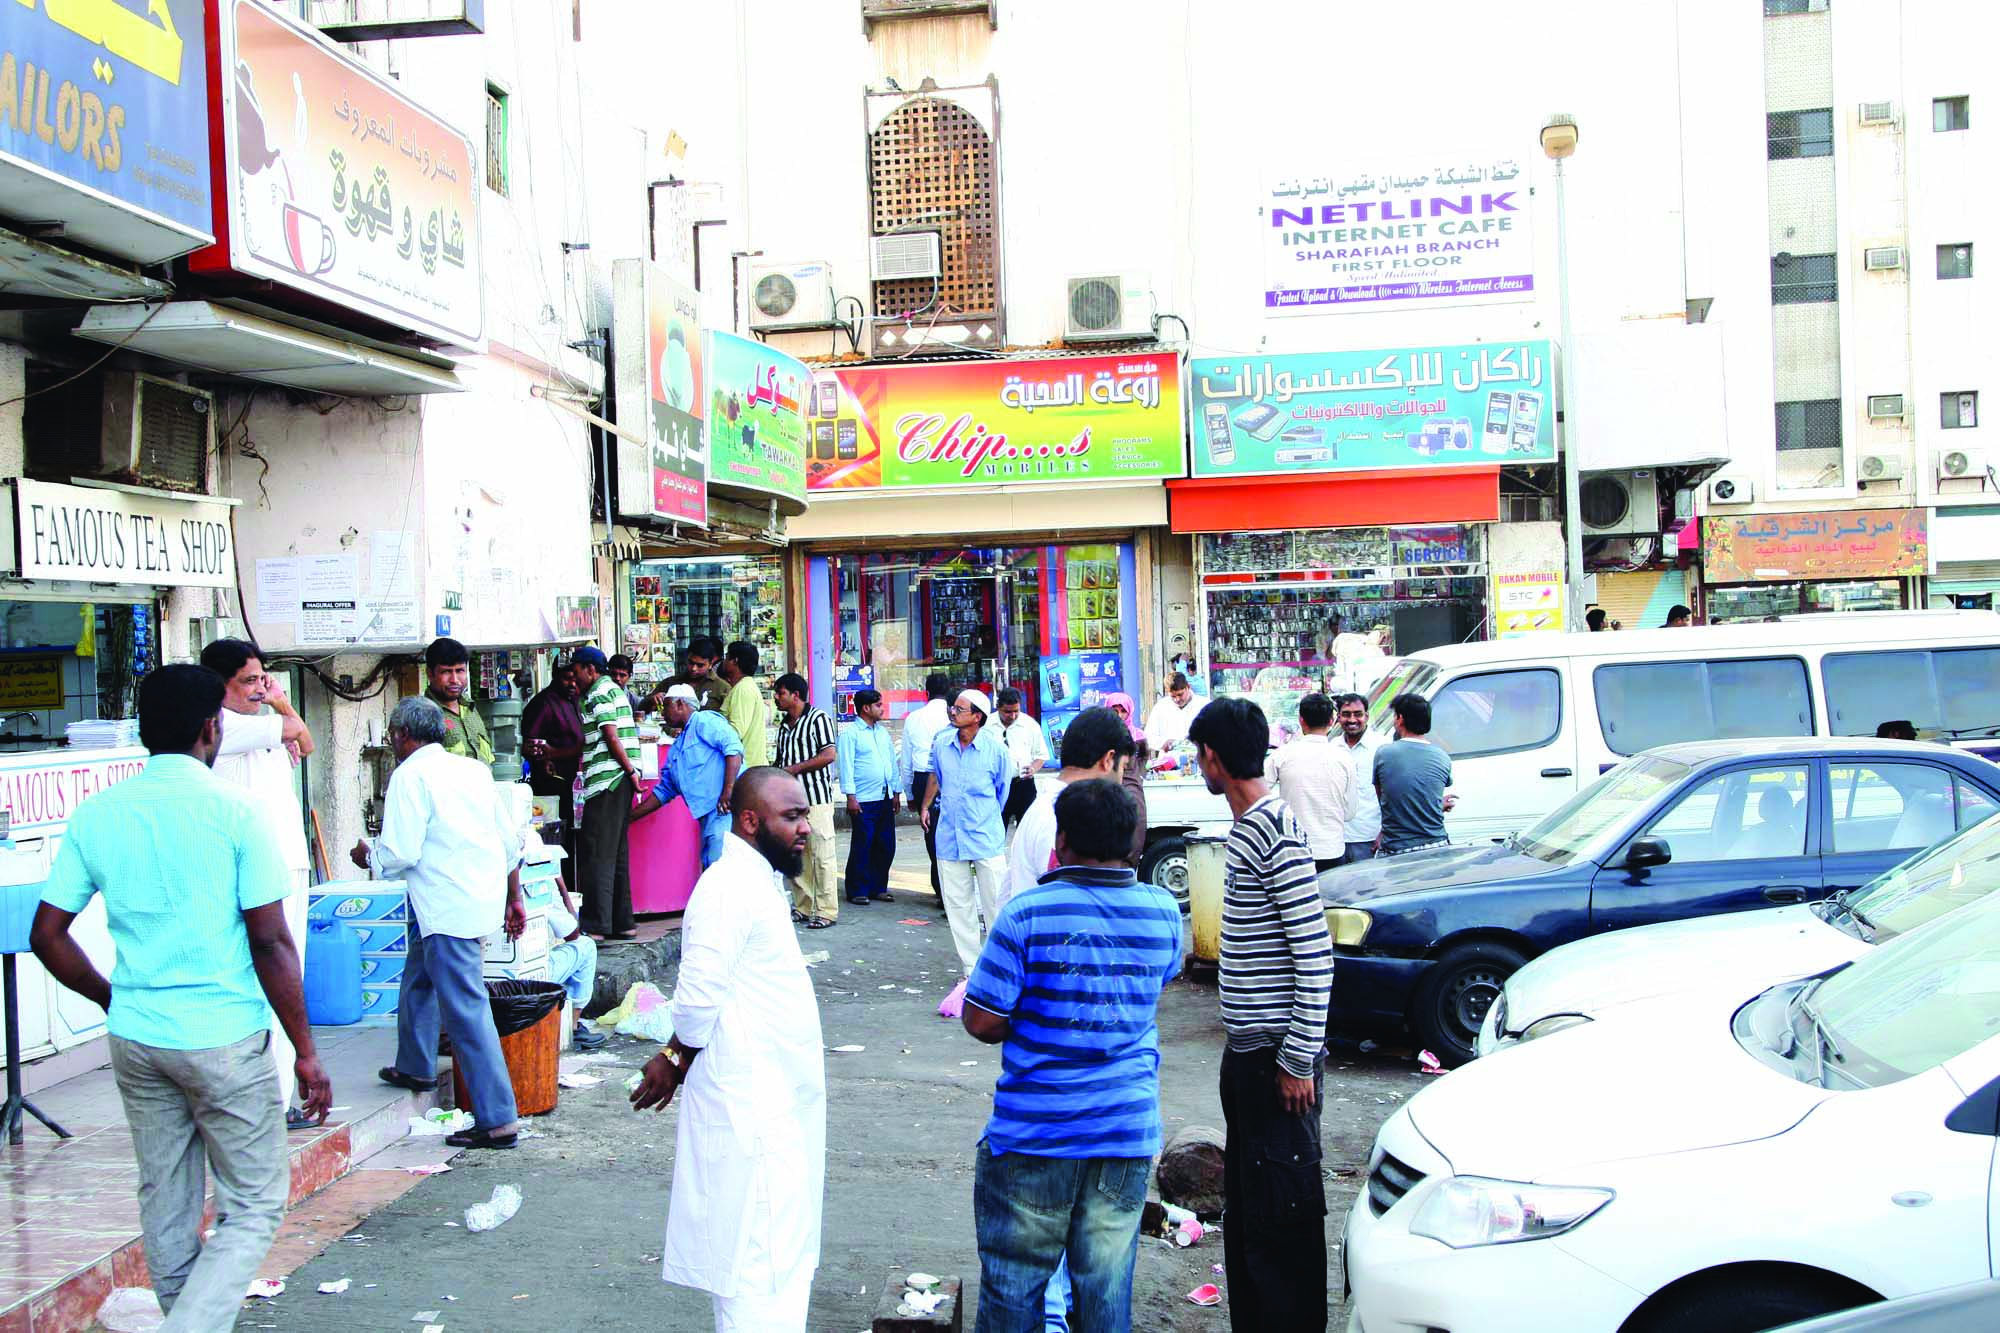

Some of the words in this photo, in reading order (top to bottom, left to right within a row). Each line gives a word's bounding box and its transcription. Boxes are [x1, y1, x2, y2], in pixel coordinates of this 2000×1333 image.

[334, 88, 395, 151] المعروف
[400, 128, 457, 183] مشروبات
[1272, 177, 1333, 200] انترنت
[1436, 164, 1488, 189] الشبكة
[329, 148, 393, 242] قهوة
[1272, 191, 1520, 227] NETLINK
[397, 205, 413, 260] و
[420, 200, 464, 276] شاي
[1283, 223, 1427, 246] INTERNET
[1439, 217, 1512, 235] CAFE
[1296, 244, 1409, 261] SHARAFIAH
[1416, 238, 1499, 254] BRANCH
[1332, 260, 1385, 273] FIRST
[1392, 255, 1462, 269] FLOOR
[1417, 282, 1453, 295] Wireless
[1455, 280, 1492, 293] Internet
[1494, 276, 1523, 290] Access
[1118, 362, 1158, 374] مؤسسة
[1201, 352, 1443, 403] للإكسسوارات
[1452, 346, 1543, 391] راكان
[1001, 375, 1083, 412] المحبة
[1089, 371, 1160, 408] روعة
[1386, 400, 1446, 415] للجوالات
[985, 459, 1090, 476] MOBILES
[31, 504, 126, 570] FAMOUS
[130, 514, 170, 572] TEA
[181, 519, 227, 575] SHOP
[1737, 517, 1827, 542] الشرقية
[1834, 514, 1894, 538] مركز
[1405, 546, 1467, 562] SERVICE
[1498, 574, 1527, 584] RAKAN
[1529, 572, 1558, 582] MOBILE
[0, 771, 65, 824] AMOUS
